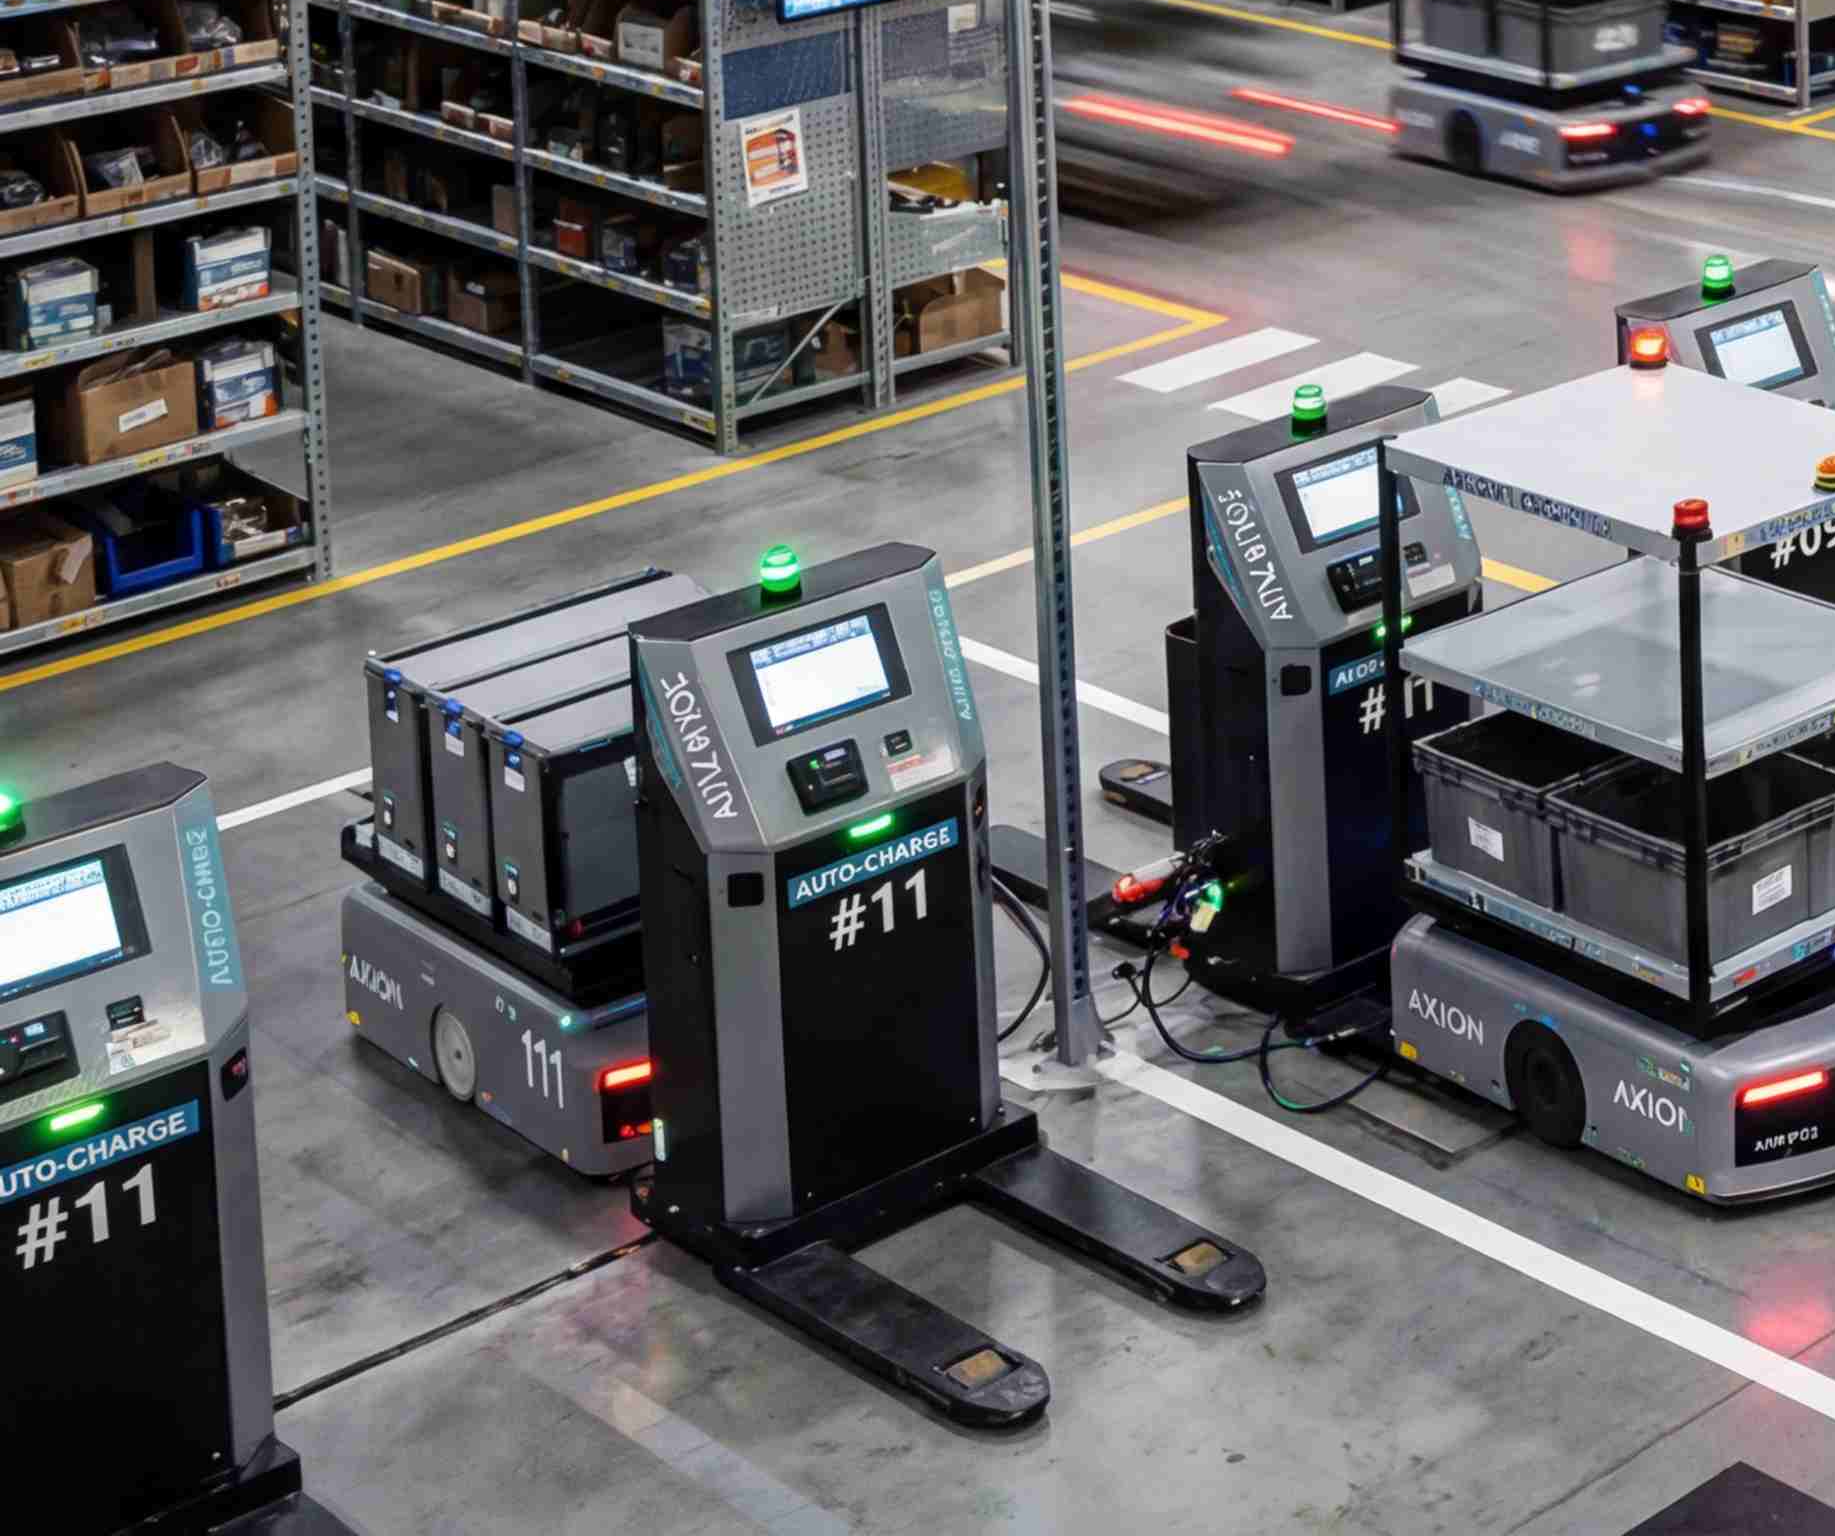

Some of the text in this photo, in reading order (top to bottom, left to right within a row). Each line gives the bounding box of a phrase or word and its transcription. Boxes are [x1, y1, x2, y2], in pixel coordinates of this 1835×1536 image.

[796, 825, 951, 901] AUTO-CHARGE
[829, 868, 927, 952] #11
[1408, 988, 1485, 1046] AXION
[521, 1029, 564, 1109] 111
[0, 1110, 187, 1198] UTO-CHARGE
[16, 1163, 157, 1270] #11
